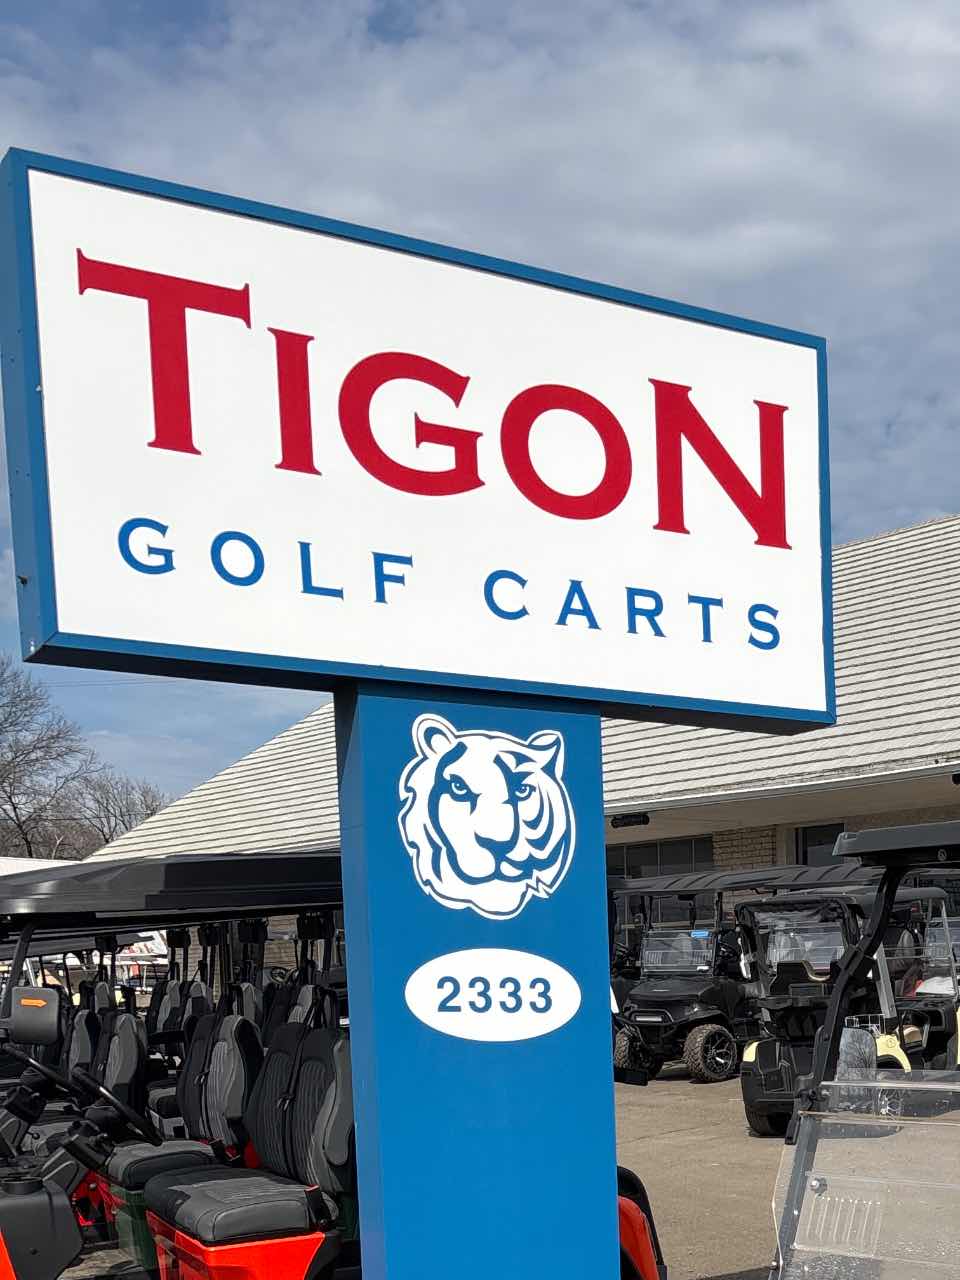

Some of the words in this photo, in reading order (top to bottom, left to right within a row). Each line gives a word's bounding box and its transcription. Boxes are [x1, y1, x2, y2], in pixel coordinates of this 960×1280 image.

[77, 249, 791, 549] TIGON
[118, 518, 413, 603] GOLF
[484, 570, 781, 650] CARTS
[437, 976, 552, 1013] 2333
